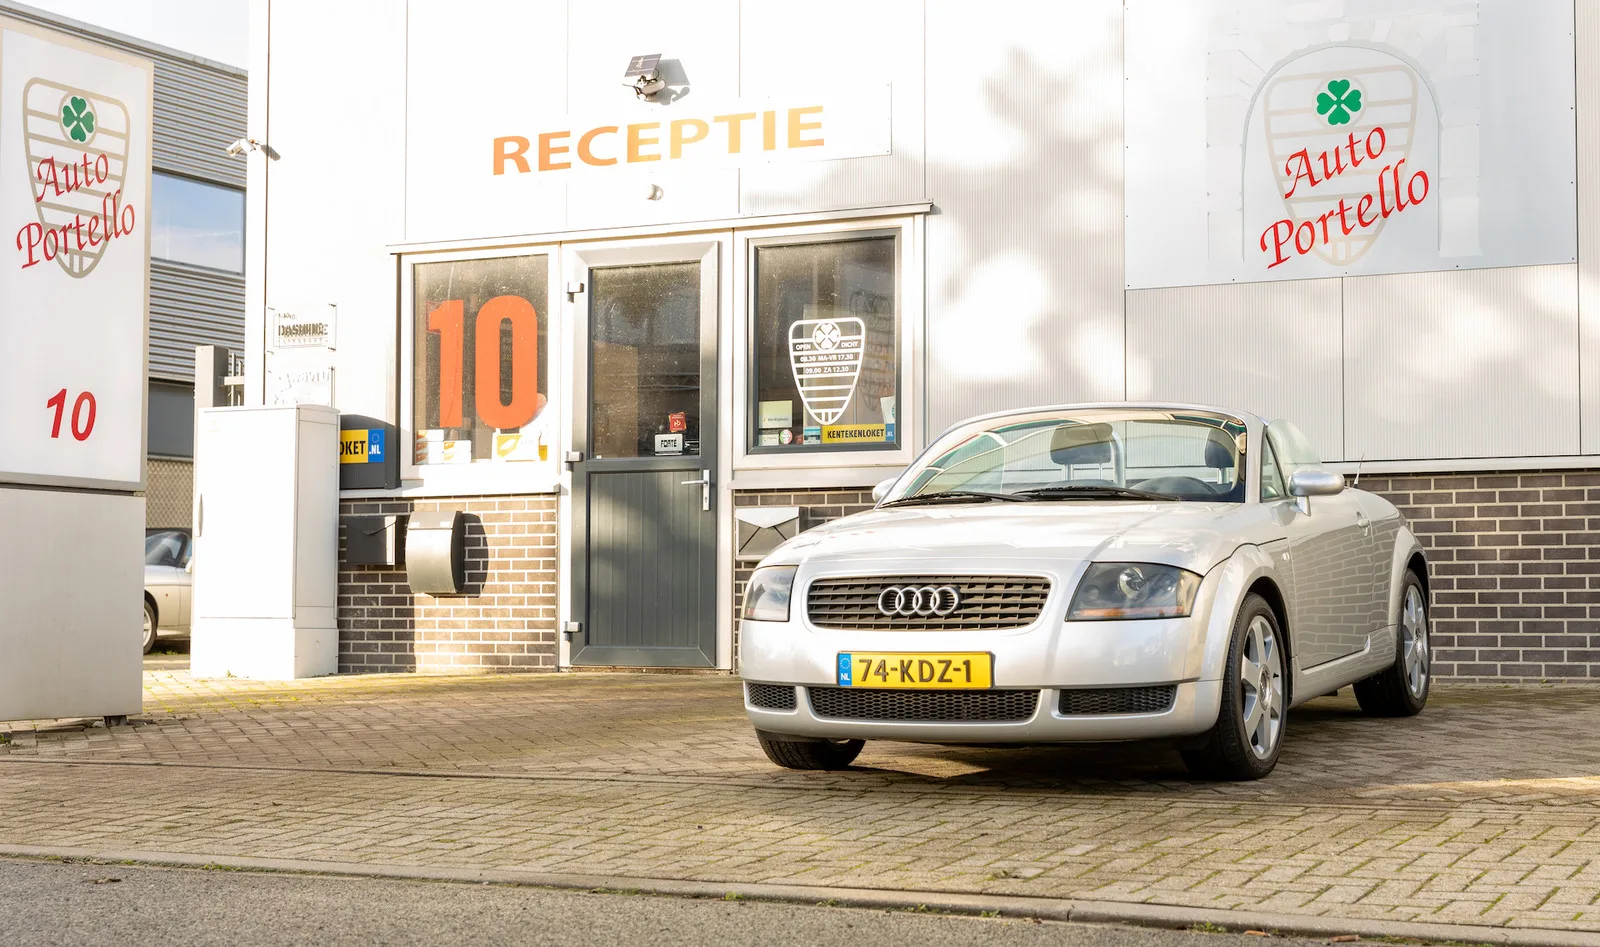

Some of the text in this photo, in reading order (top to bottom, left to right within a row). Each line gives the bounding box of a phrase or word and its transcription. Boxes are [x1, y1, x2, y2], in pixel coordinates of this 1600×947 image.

[493, 106, 825, 175] RECEPTIE
[1284, 127, 1386, 199] Auto
[36, 154, 109, 203] Auto
[16, 189, 135, 269] Portello
[1260, 158, 1430, 269] Portello
[425, 296, 538, 429] 10
[795, 343, 811, 351] OPEN
[832, 365, 849, 373] 12.30
[837, 353, 854, 361] 17.30
[46, 388, 97, 441] 10
[827, 428, 885, 439] KENTEKENLOKET
[368, 444, 381, 455] .NL
[840, 658, 972, 683] NL 74-KDZ-1
